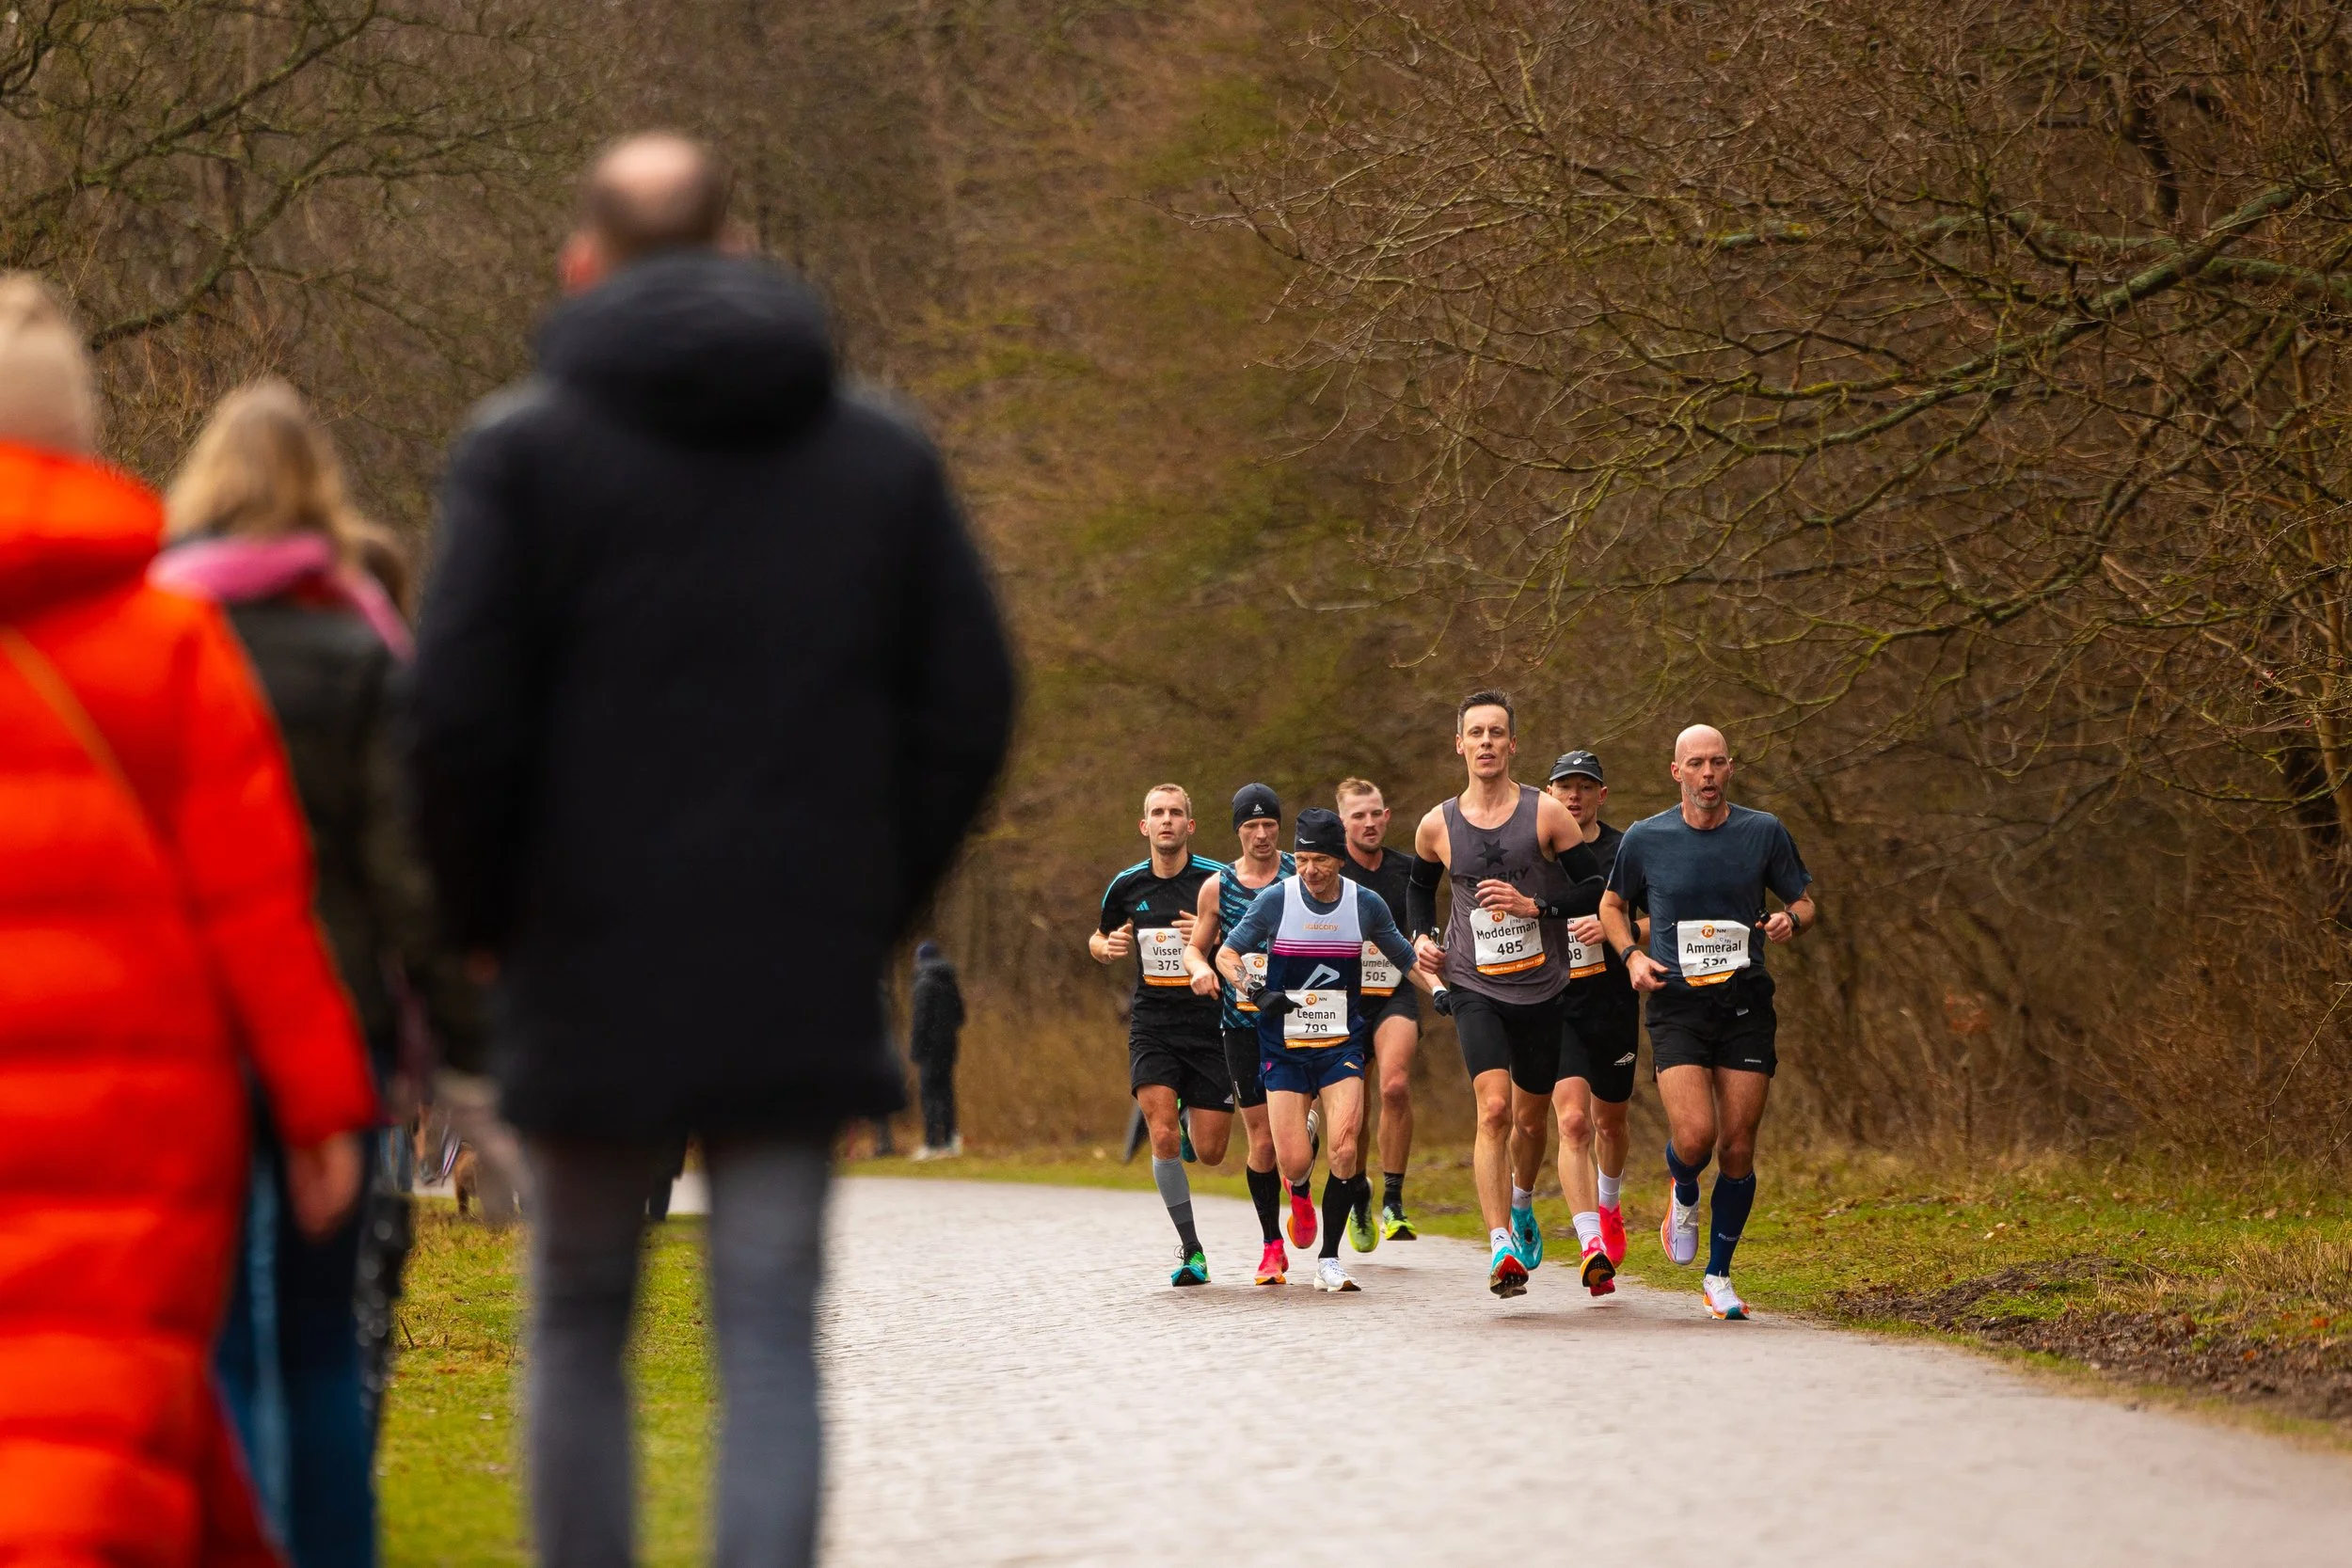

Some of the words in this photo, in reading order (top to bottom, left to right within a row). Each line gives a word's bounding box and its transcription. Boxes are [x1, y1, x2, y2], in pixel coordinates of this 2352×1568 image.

[1476, 922, 1537, 940] Modderman
[1152, 946, 1183, 957] Visser
[1497, 940, 1523, 955] 485
[1686, 940, 1741, 954] Ammeraal
[1157, 959, 1180, 971] 375
[1365, 971, 1387, 982] 505
[1297, 1009, 1336, 1019] Leeman
[1305, 1023, 1327, 1033] 799
